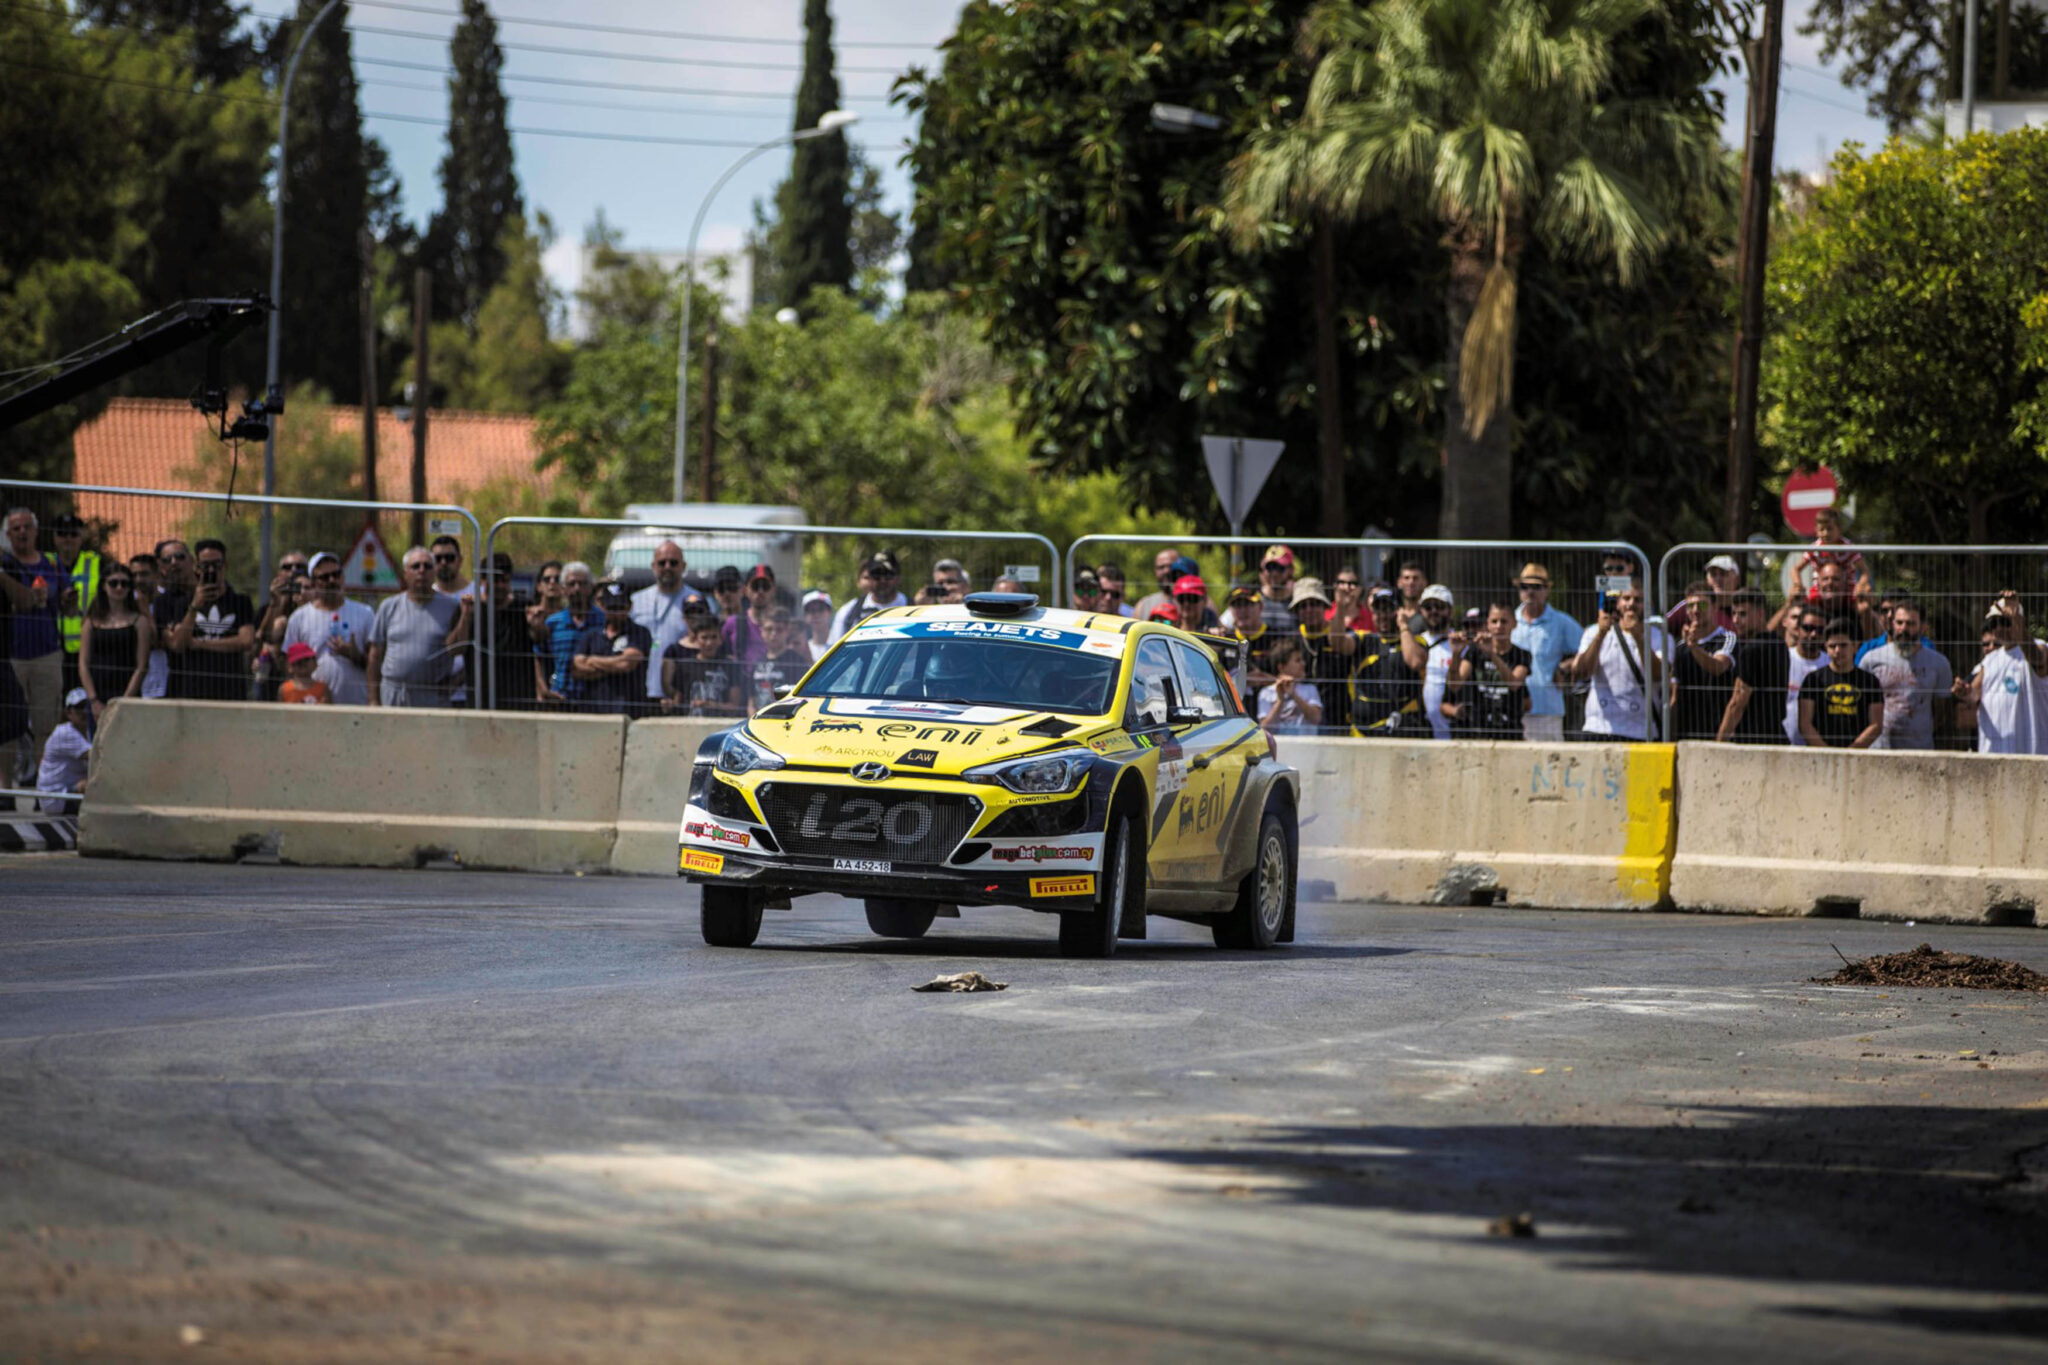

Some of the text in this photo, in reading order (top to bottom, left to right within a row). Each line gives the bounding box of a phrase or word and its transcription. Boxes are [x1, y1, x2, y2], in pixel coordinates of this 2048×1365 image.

[926, 622, 1062, 640] SEAJETS
[876, 723, 985, 746] eni
[835, 747, 896, 758] ARGYROU
[907, 751, 934, 762] LAW
[1196, 772, 1226, 834] eni
[686, 853, 720, 869] PIRELLI
[836, 860, 890, 872] AA 452-18
[1035, 879, 1088, 893] PIRELLI
